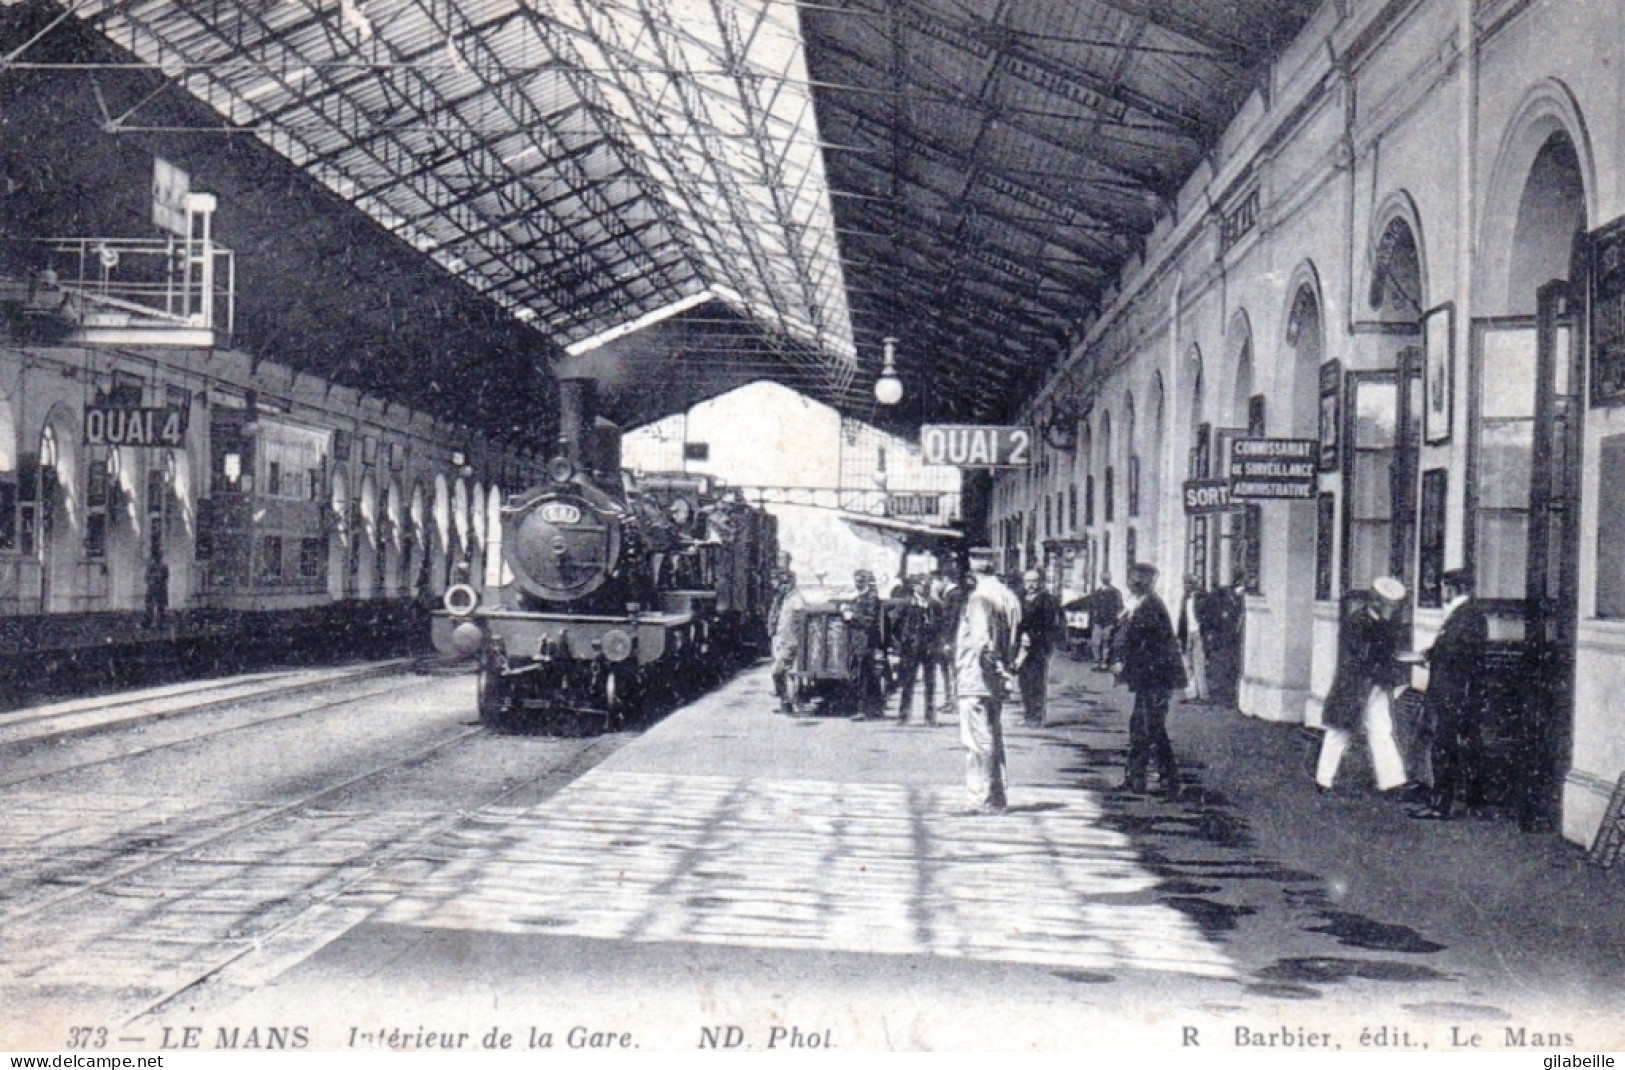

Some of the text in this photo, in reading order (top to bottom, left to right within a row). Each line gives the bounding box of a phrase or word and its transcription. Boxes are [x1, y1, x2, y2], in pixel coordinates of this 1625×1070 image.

[88, 410, 180, 444] QUAI 4
[926, 429, 1029, 464] QUAI 2
[1186, 486, 1243, 507] SORT
